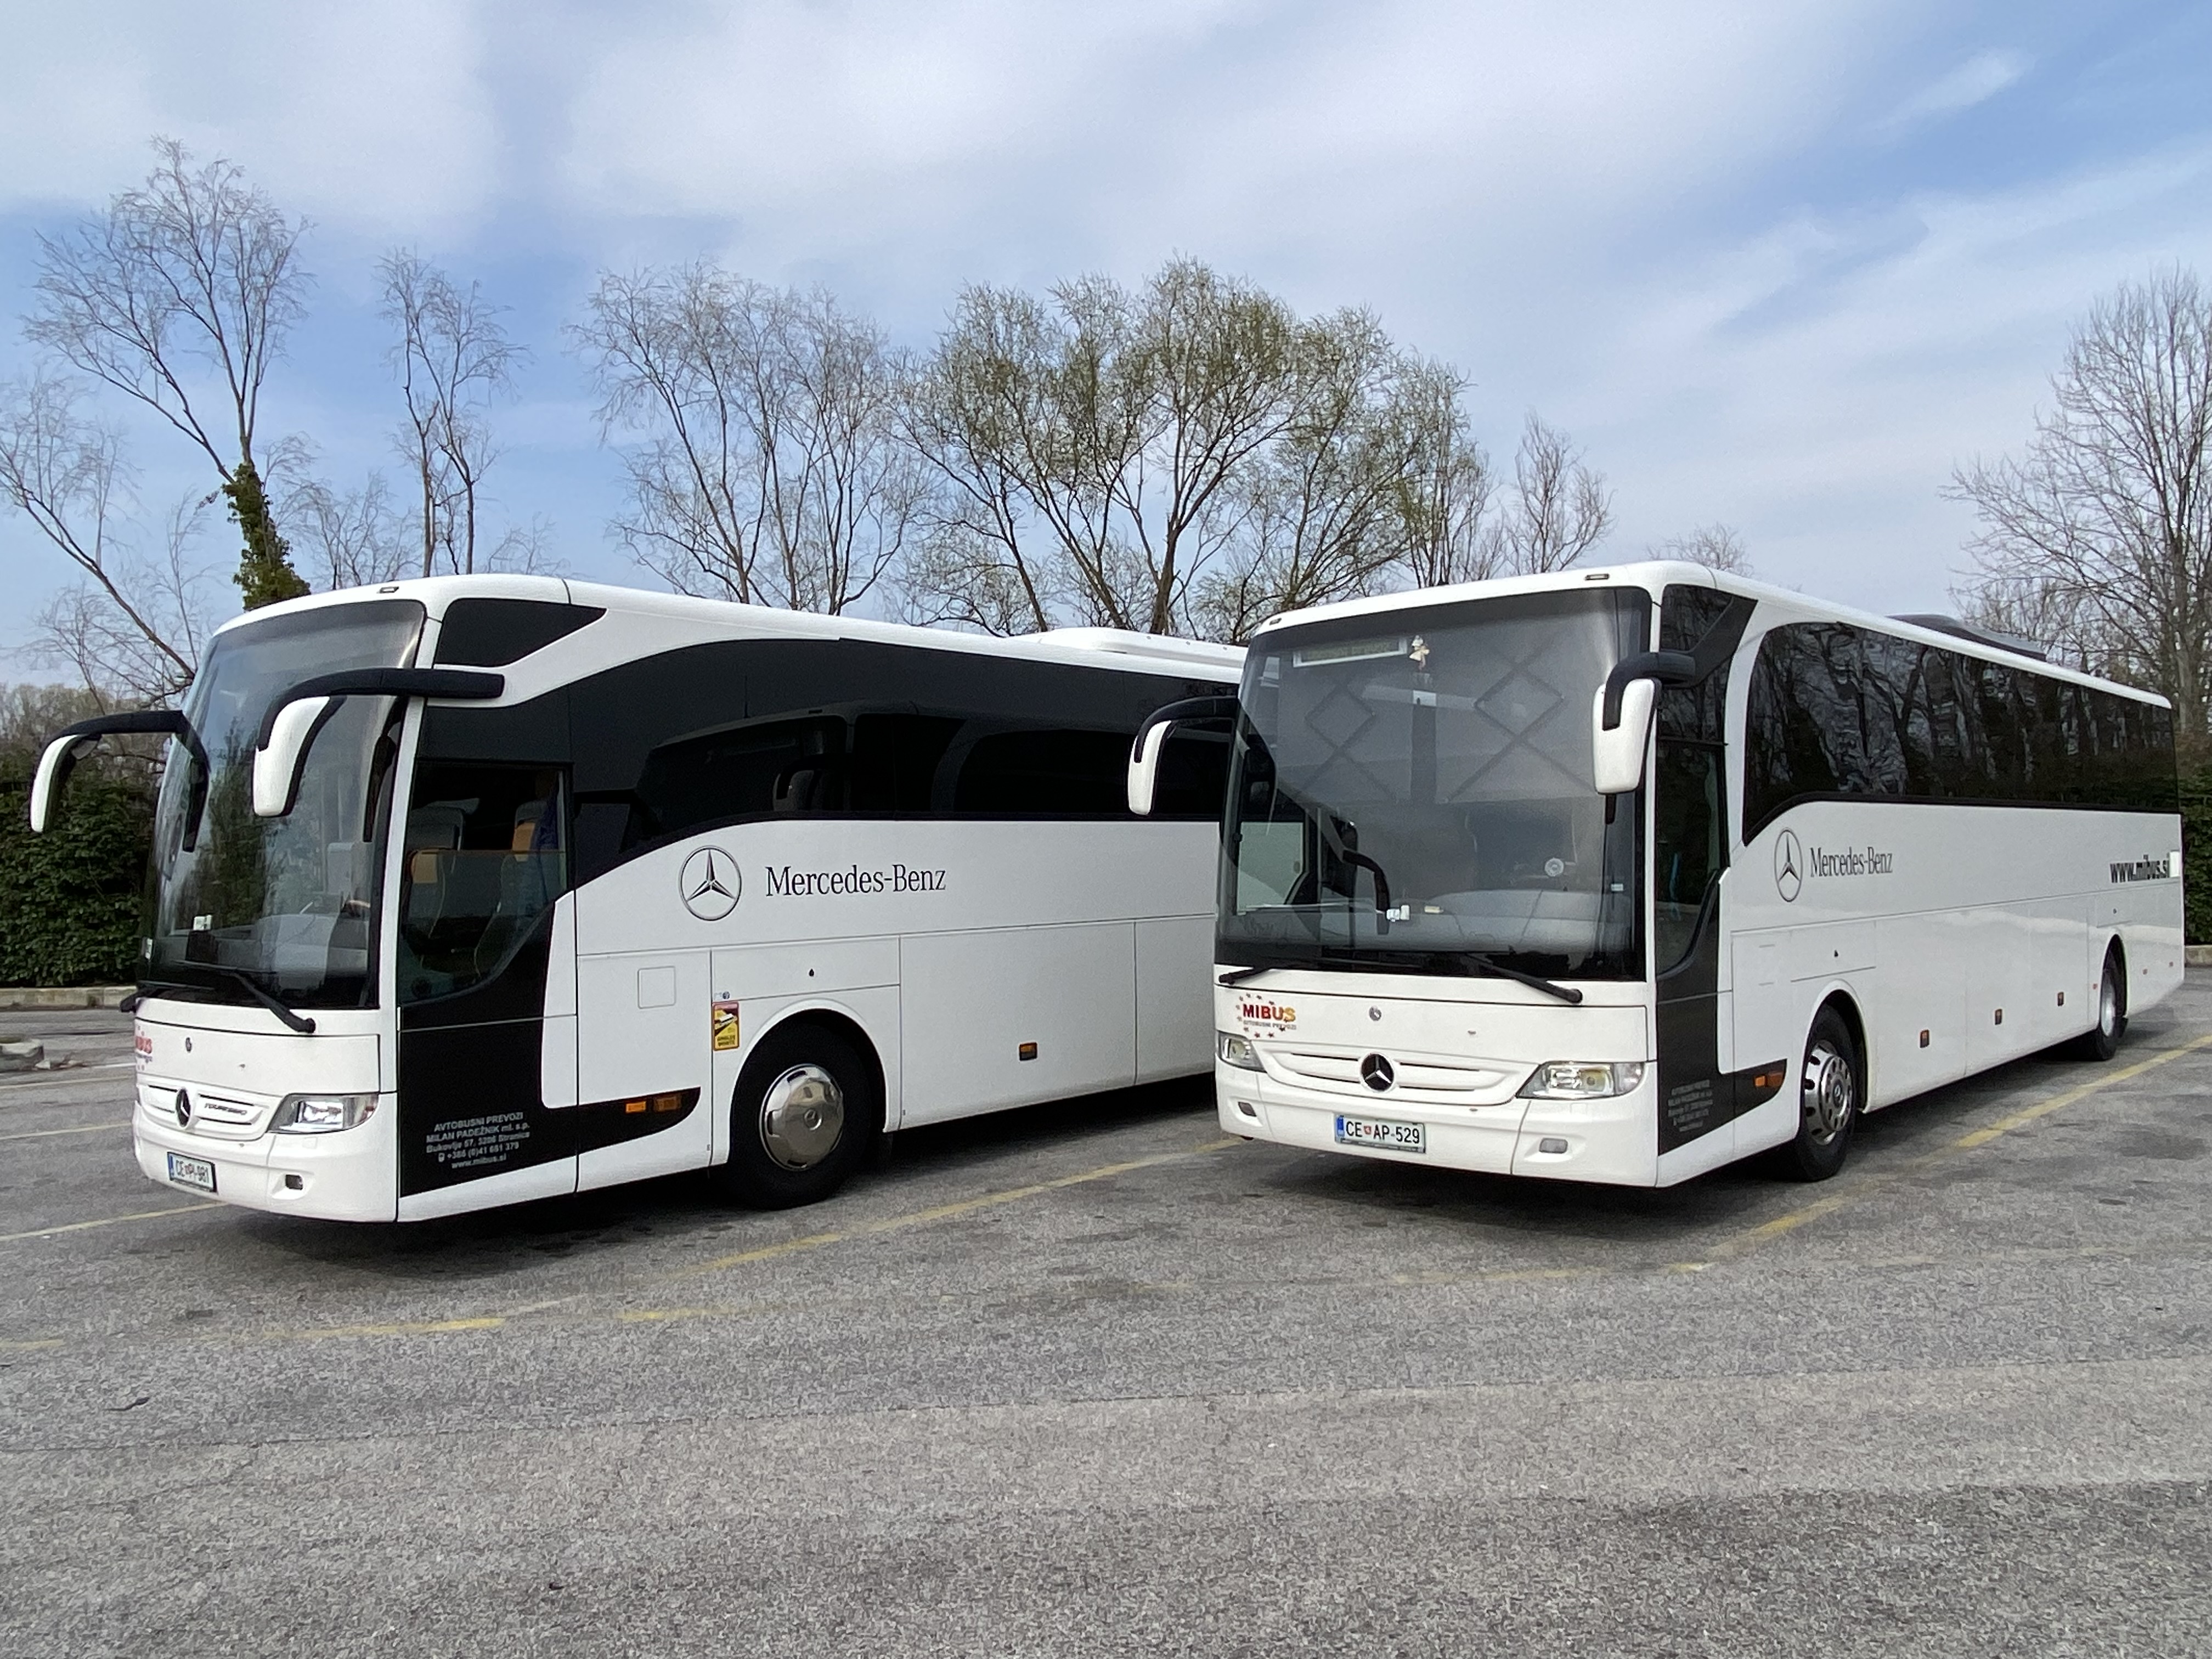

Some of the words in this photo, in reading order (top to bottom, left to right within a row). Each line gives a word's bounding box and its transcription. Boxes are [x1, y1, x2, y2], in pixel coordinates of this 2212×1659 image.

[1810, 846, 1892, 877] Mercedes-Benz
[2110, 852, 2170, 883] www.mibus.si
[765, 864, 946, 896] Mercedes-Benz
[1243, 1003, 1296, 1022] MIBUS
[434, 1117, 485, 1132] AVTOBUSNI
[486, 1112, 523, 1124] PREVOZI
[1346, 1121, 1362, 1137] CE
[1373, 1125, 1420, 1144] AP-529
[426, 1132, 455, 1143] MILAN
[452, 1153, 507, 1169] www.mibus.si
